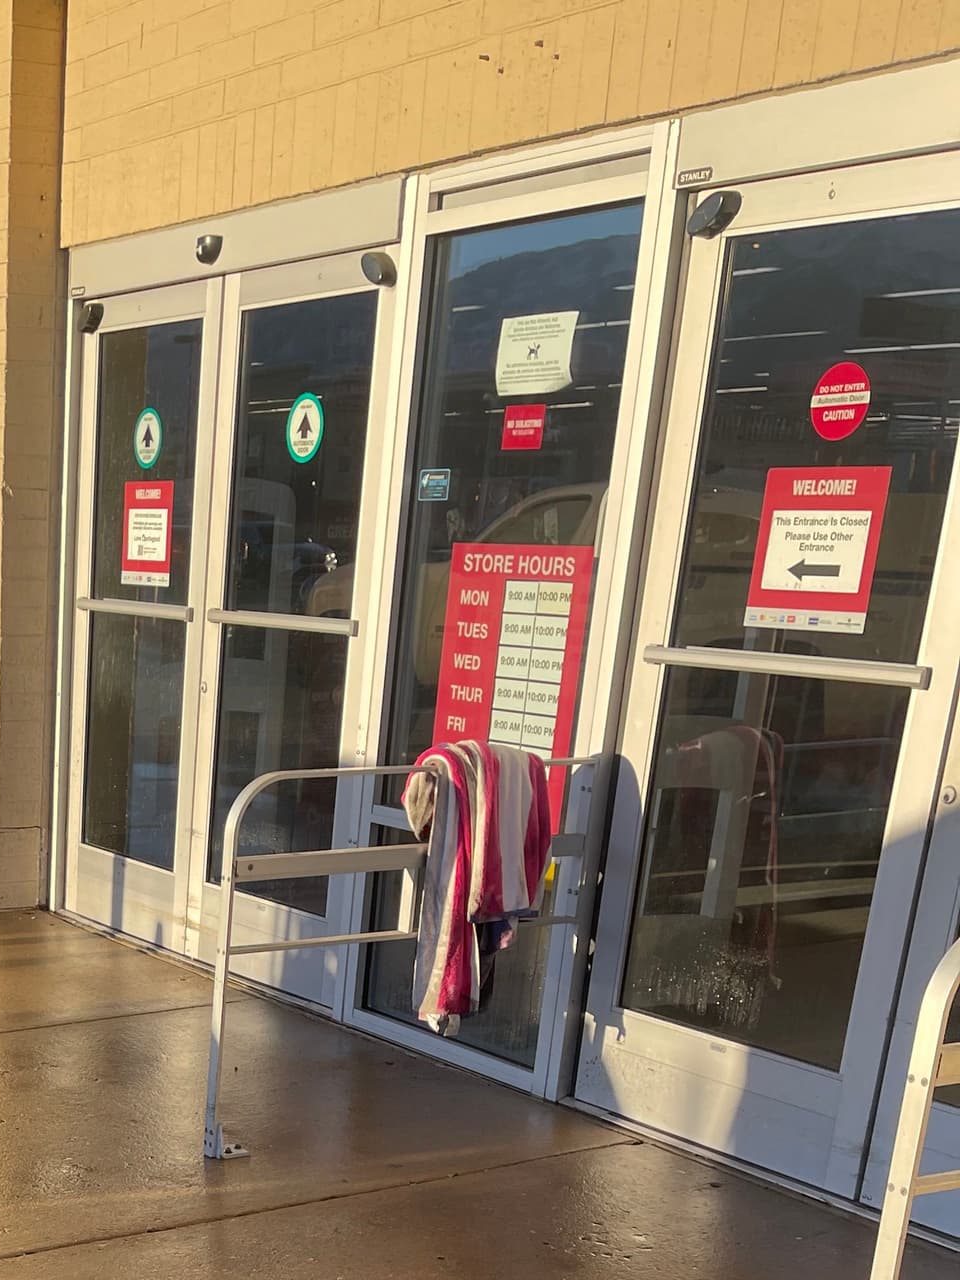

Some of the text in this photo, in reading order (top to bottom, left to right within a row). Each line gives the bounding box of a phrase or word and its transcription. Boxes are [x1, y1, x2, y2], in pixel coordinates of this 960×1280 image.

[680, 169, 711, 183] STANLEY
[820, 382, 866, 394] DO NOT ENTER
[849, 394, 865, 403] Door
[823, 409, 856, 422] CAUTION
[793, 479, 857, 496] WELCOME!
[776, 515, 869, 527] This Entrance Is Closed
[785, 531, 854, 542] Please Use Other
[798, 542, 835, 553] Entrance
[463, 553, 576, 577] STORE HOURS
[460, 589, 490, 607] MON
[508, 590, 523, 601] 9:00
[524, 591, 536, 602] AM
[539, 591, 558, 602] 10:00
[457, 621, 489, 640] TUES
[504, 623, 519, 634] 9:00
[520, 624, 532, 635] AM
[535, 626, 554, 637] 10:00
[453, 652, 481, 671] WED
[500, 655, 515, 666] 9:00
[516, 656, 528, 667] AM
[531, 658, 550, 670] 10:00
[450, 684, 483, 703] THUR
[497, 687, 512, 698] 9:00
[513, 688, 524, 699] AM
[528, 691, 546, 703] 10:00
[446, 715, 466, 733] FRI
[494, 719, 509, 730] 9:00
[509, 720, 521, 731] AM
[524, 724, 543, 735] 10:00
